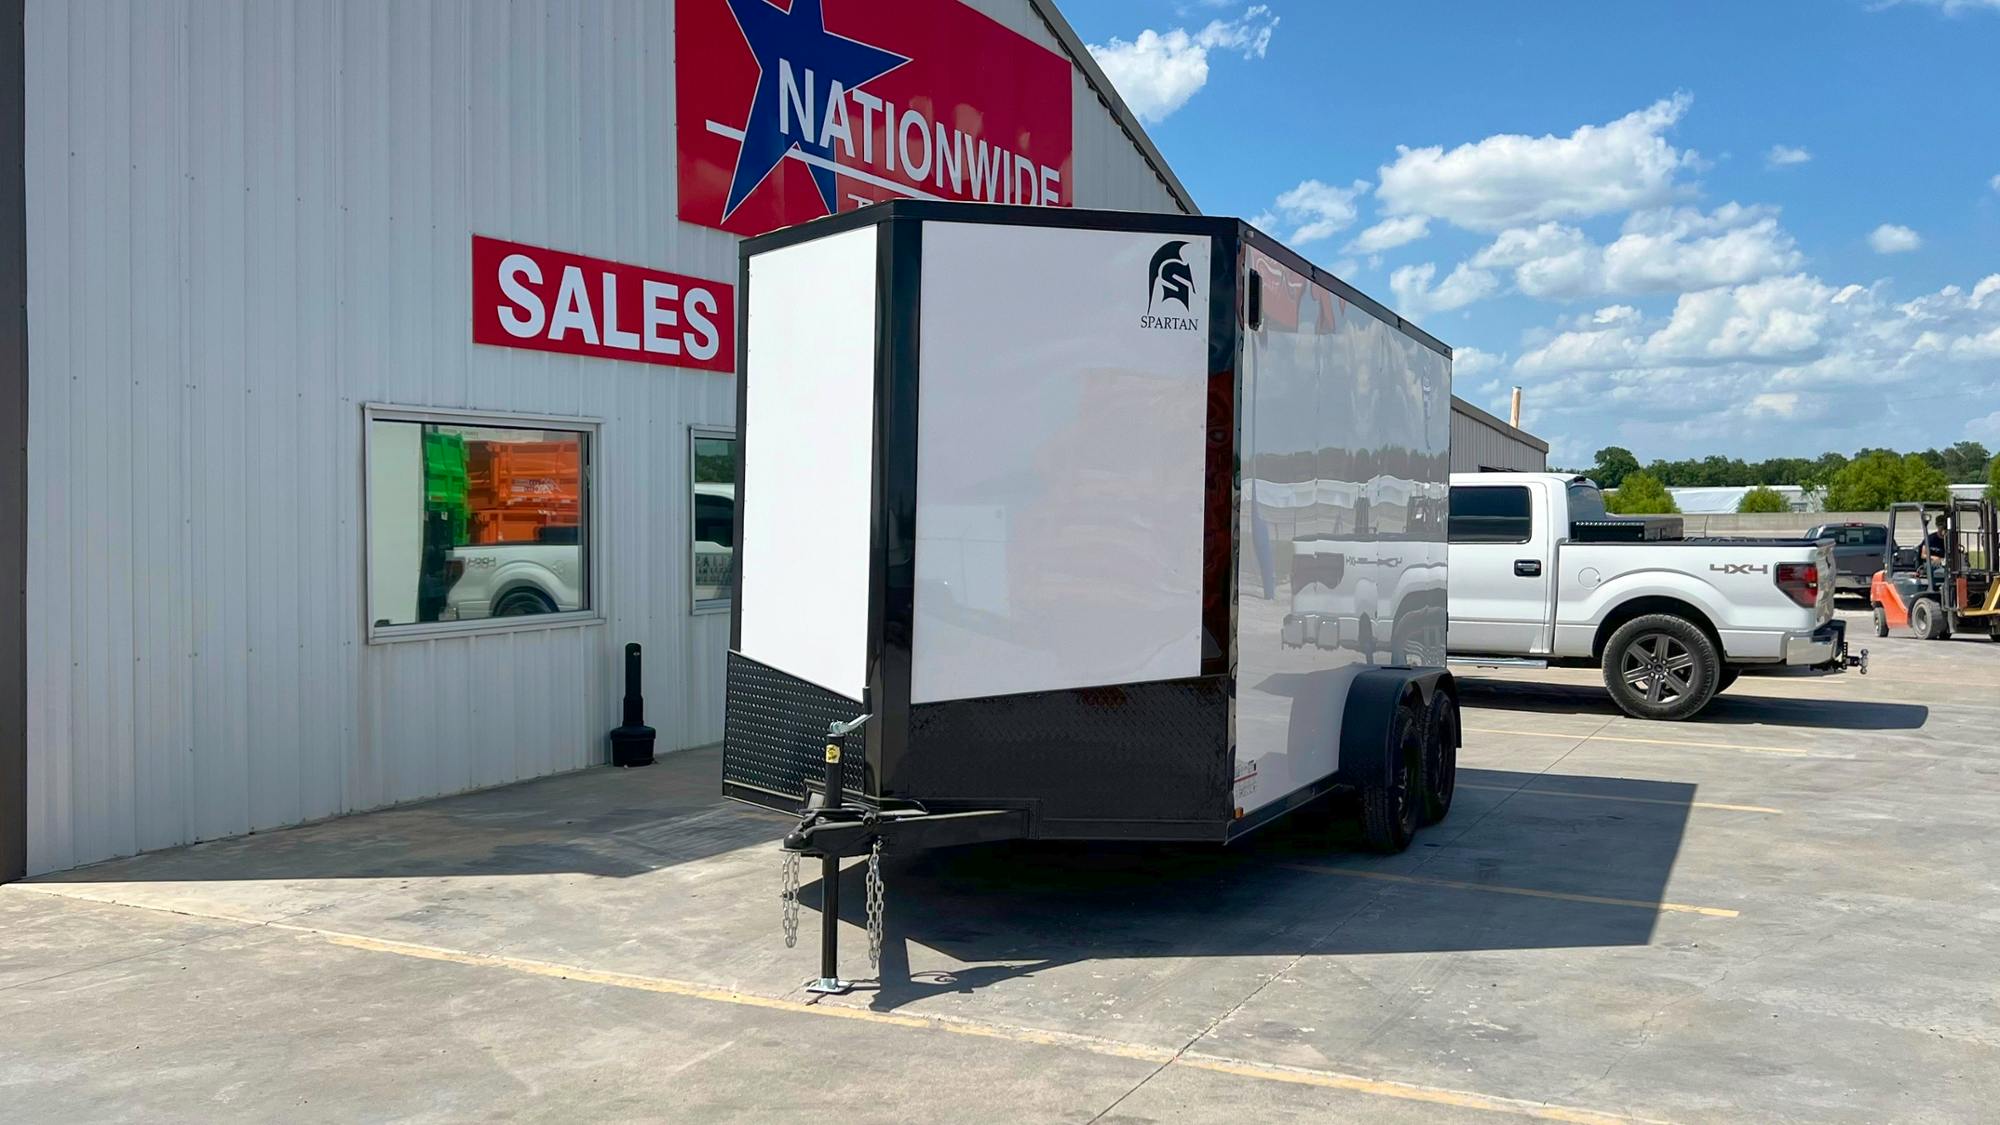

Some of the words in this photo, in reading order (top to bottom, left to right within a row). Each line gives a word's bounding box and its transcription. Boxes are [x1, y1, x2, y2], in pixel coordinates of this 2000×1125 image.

[779, 58, 1061, 207] NATIONWIDE
[497, 253, 720, 361] SALES
[1140, 315, 1199, 331] SPARTAN
